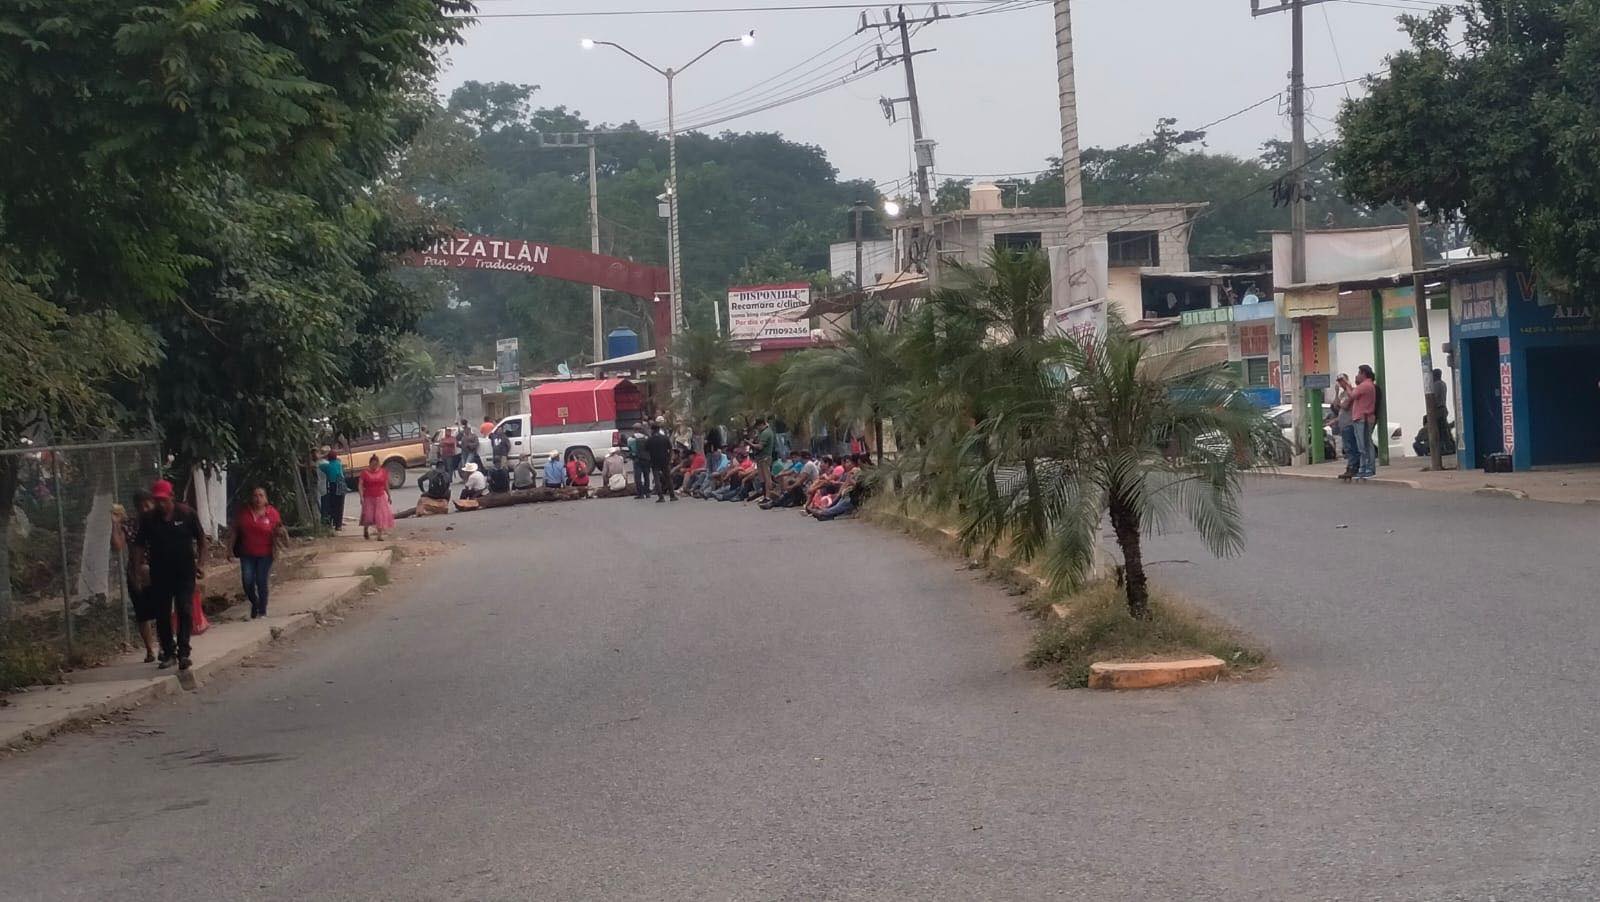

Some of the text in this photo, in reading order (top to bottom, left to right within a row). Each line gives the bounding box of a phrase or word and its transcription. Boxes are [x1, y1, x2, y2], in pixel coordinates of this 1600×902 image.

[422, 238, 549, 264] RIZATLÁN
[457, 257, 466, 267] y
[475, 259, 534, 273] Tradición
